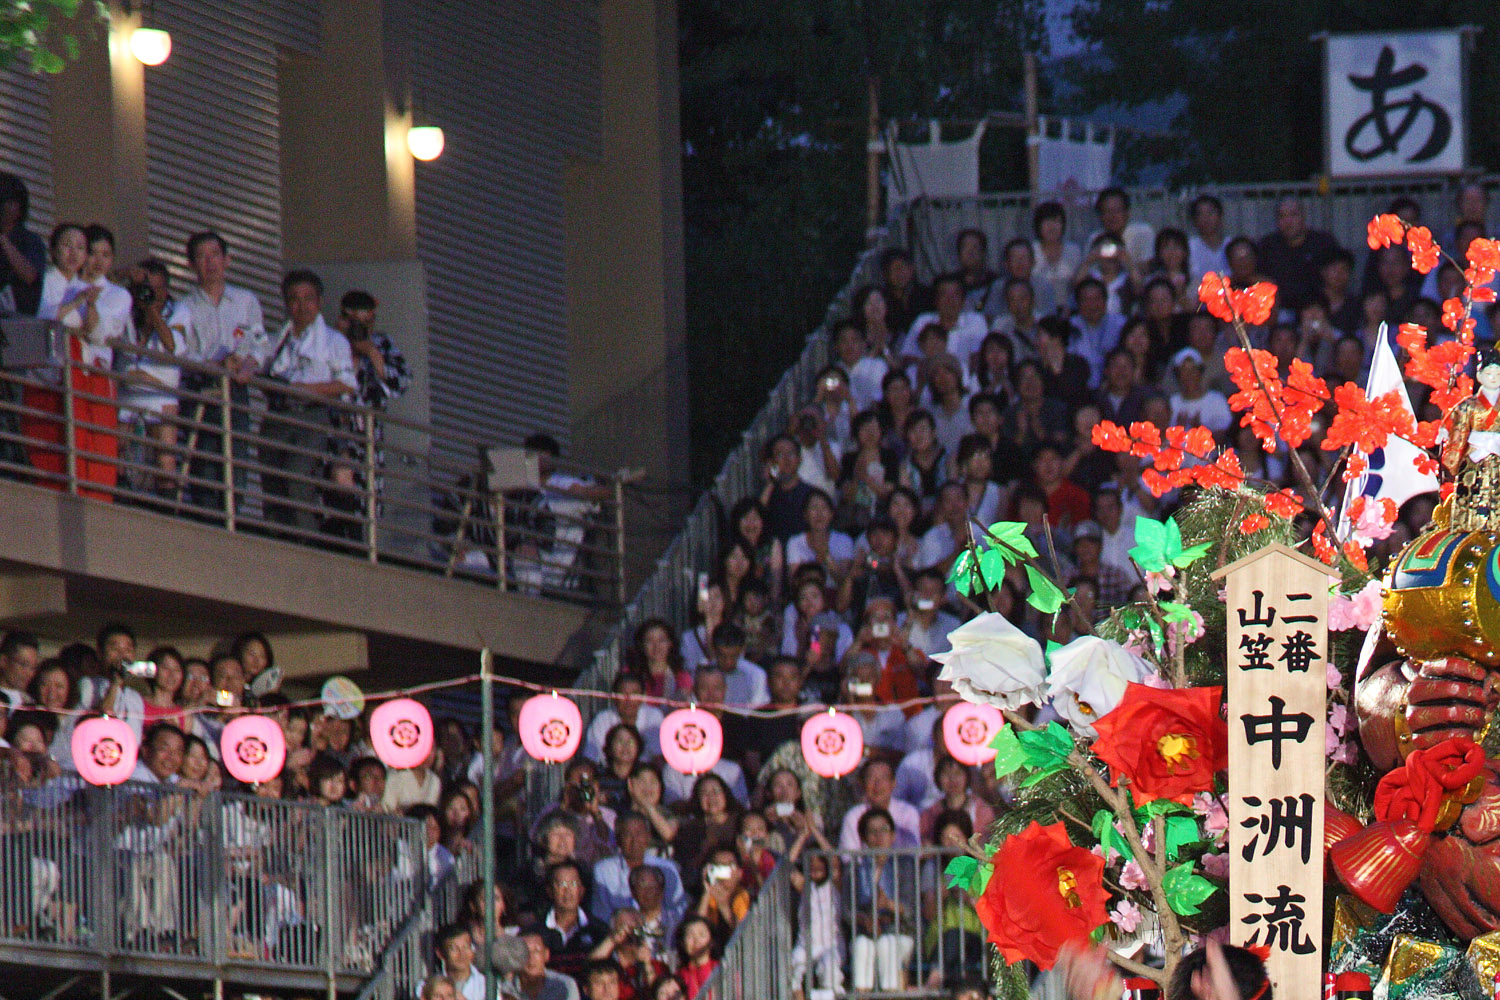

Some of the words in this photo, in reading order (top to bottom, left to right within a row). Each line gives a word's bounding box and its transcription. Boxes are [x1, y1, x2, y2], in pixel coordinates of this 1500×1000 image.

[1345, 44, 1452, 164] あ
[1237, 590, 1276, 672] 山笠
[1279, 592, 1321, 673] 二番
[1240, 695, 1317, 955] 中洲流
